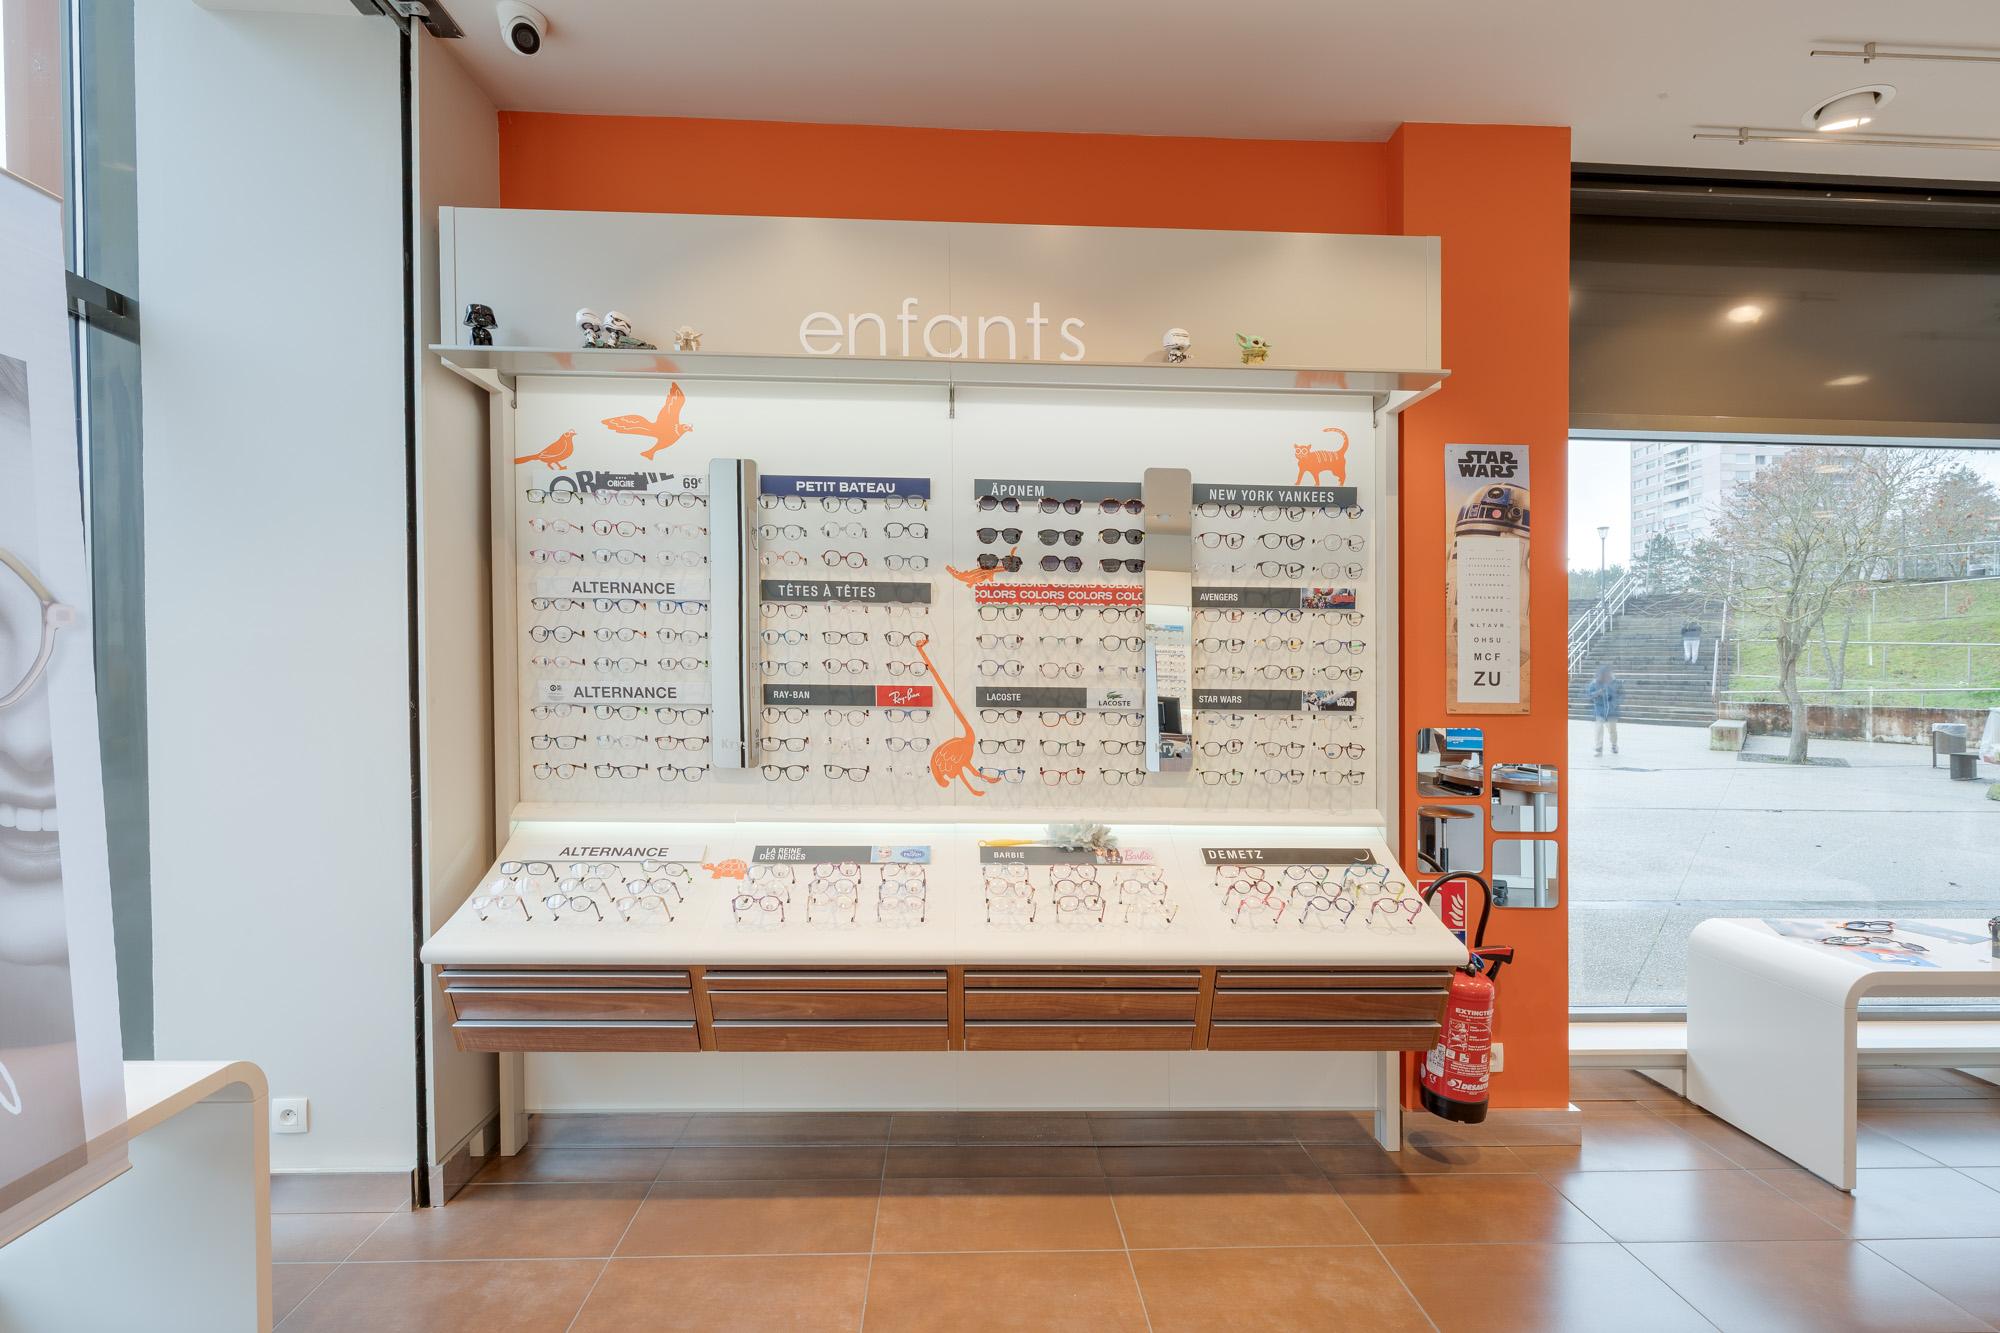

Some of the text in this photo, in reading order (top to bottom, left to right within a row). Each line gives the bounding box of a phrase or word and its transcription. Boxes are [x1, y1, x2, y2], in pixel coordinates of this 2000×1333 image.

[799, 297, 1086, 361] enfants
[1457, 450, 1518, 464] STAR
[1458, 464, 1518, 478] WARS
[796, 481, 896, 494] PETIT BATEAU
[991, 482, 1045, 497] ÄPONEM
[1209, 488, 1335, 503] NEW YORK YANKEES
[571, 581, 676, 595] ALTERNANCE
[778, 583, 876, 598] TÊTES À TÊTES
[1020, 590, 1065, 600] COLORS
[1068, 591, 1113, 600] COLORS
[1199, 592, 1238, 602] AVENGERS
[573, 686, 677, 699] ALTERNANCE
[773, 690, 810, 699] RAY-BAN
[888, 688, 921, 704] Ray-Ban
[986, 692, 1021, 701] LACOSTE
[1198, 695, 1242, 704] STAR WARS
[559, 846, 669, 857] ALTERNANCE
[993, 851, 1025, 859] BARBIE
[1208, 850, 1264, 860] DEMETZ
